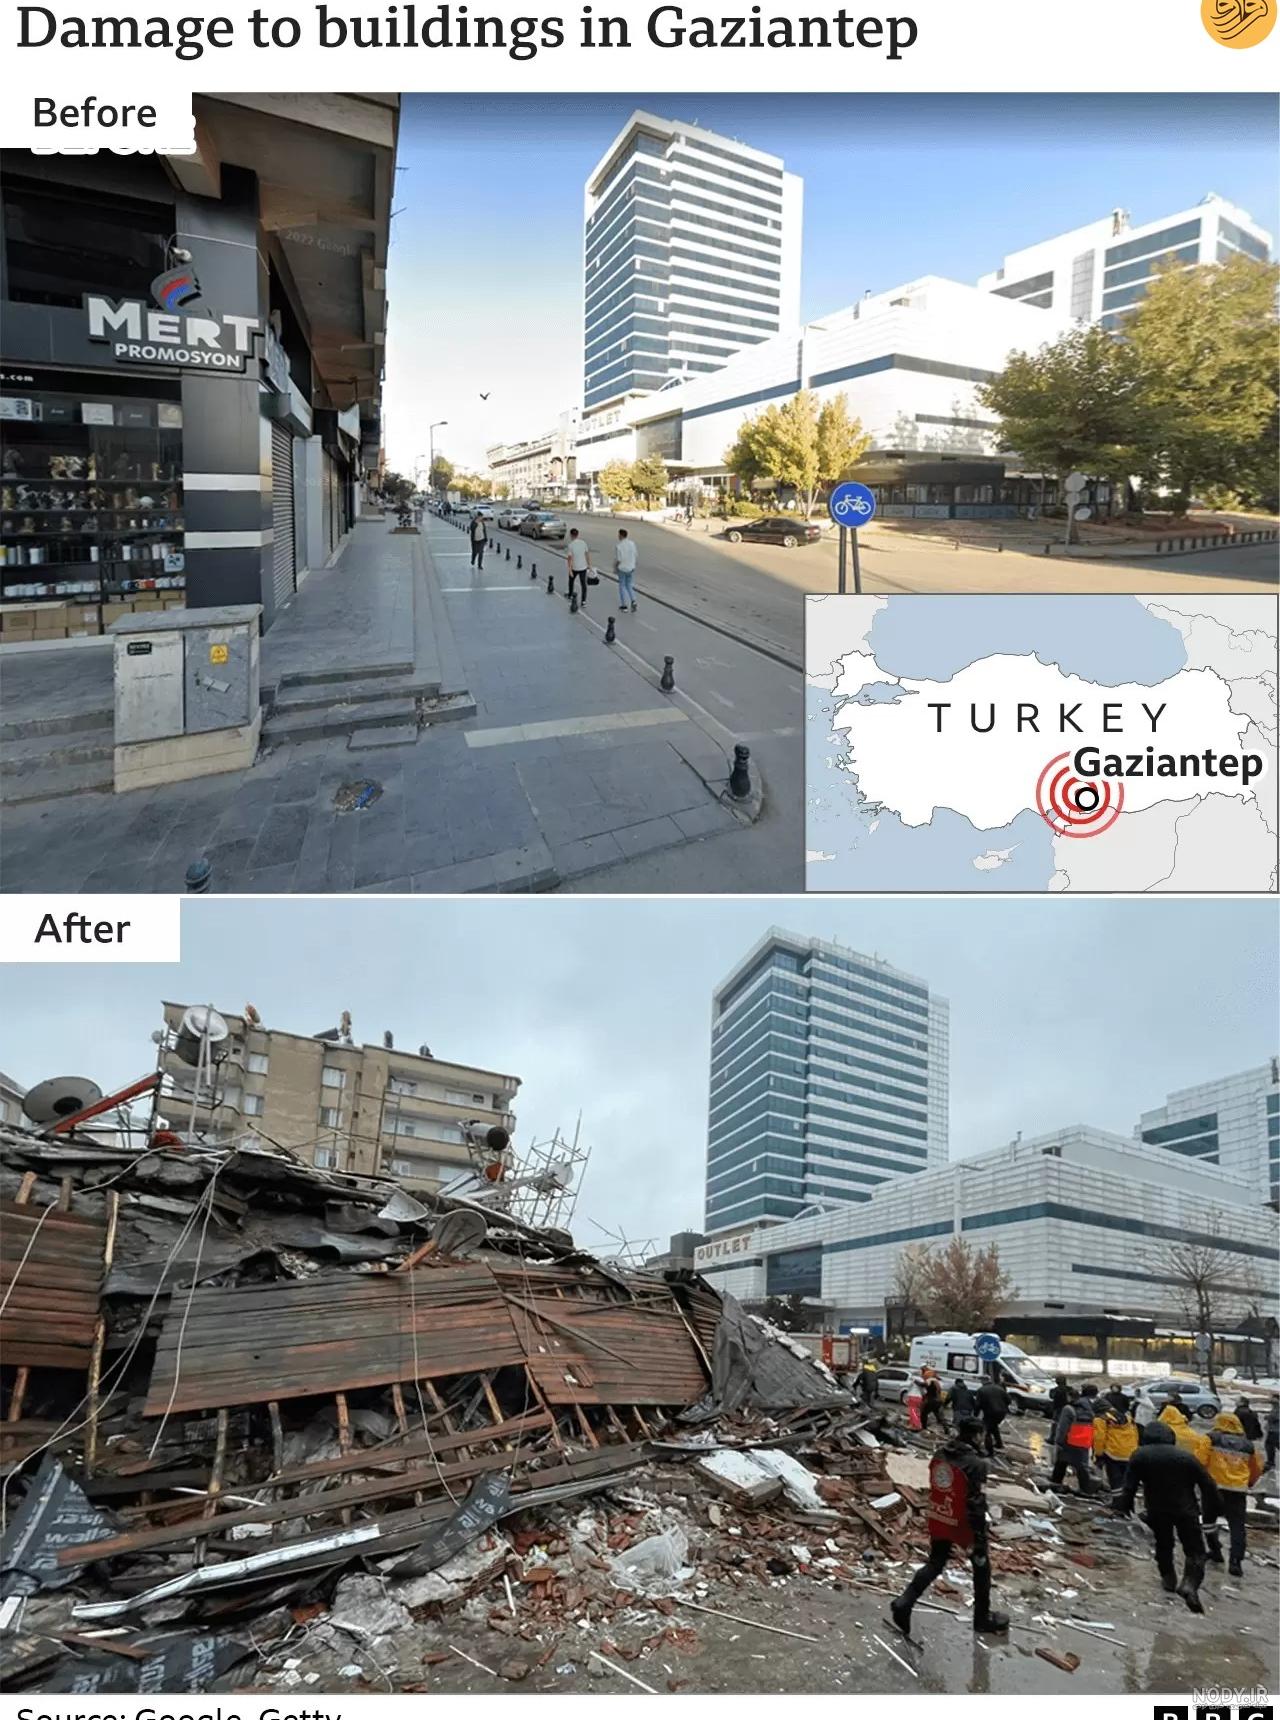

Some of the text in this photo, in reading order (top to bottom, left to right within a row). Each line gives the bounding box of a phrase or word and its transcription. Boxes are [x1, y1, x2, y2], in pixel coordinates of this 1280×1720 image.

[88, 297, 260, 352] MERT
[115, 342, 241, 368] PROMOSYON
[697, 1237, 750, 1259] OUTLET
